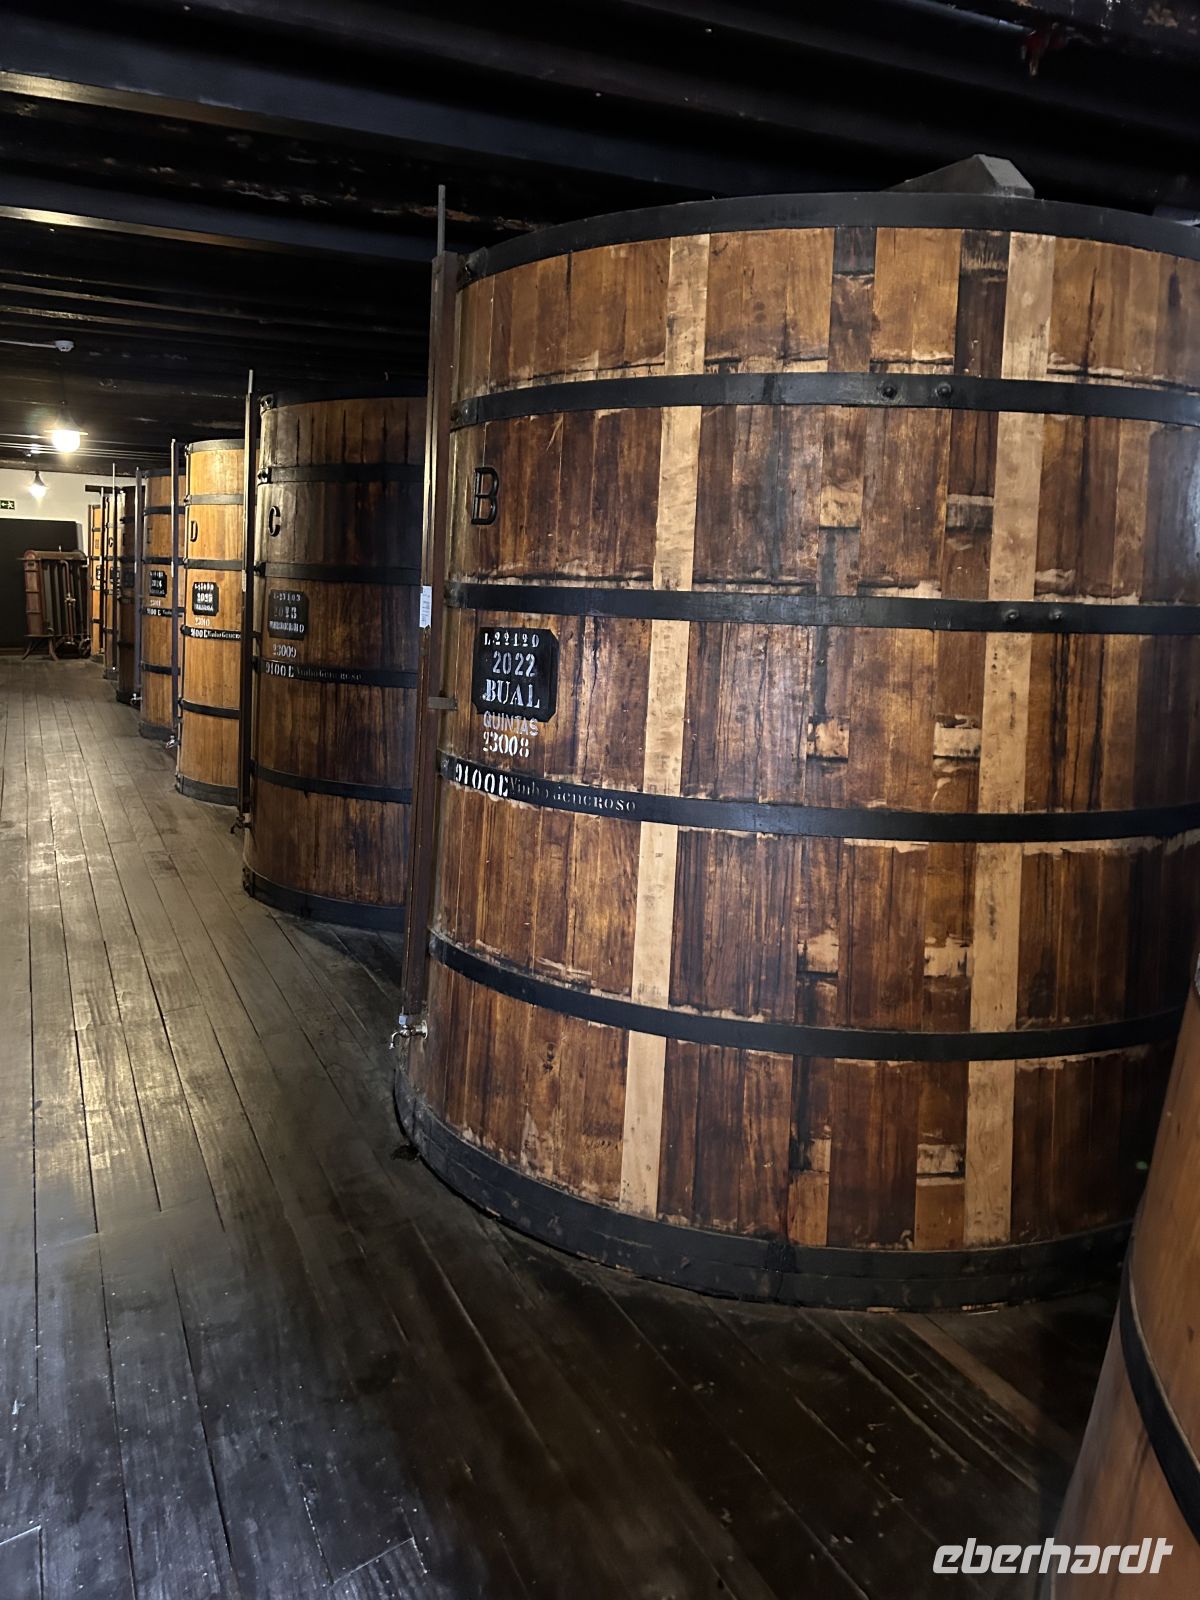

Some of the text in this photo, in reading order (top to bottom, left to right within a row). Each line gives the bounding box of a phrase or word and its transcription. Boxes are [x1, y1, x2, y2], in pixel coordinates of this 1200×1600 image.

[471, 467, 499, 525] B
[190, 520, 199, 542] D
[269, 505, 281, 537] C
[492, 650, 536, 678] 2022
[482, 679, 540, 709] BUAL
[483, 711, 539, 737] QUINTAS
[483, 731, 530, 758] 23008
